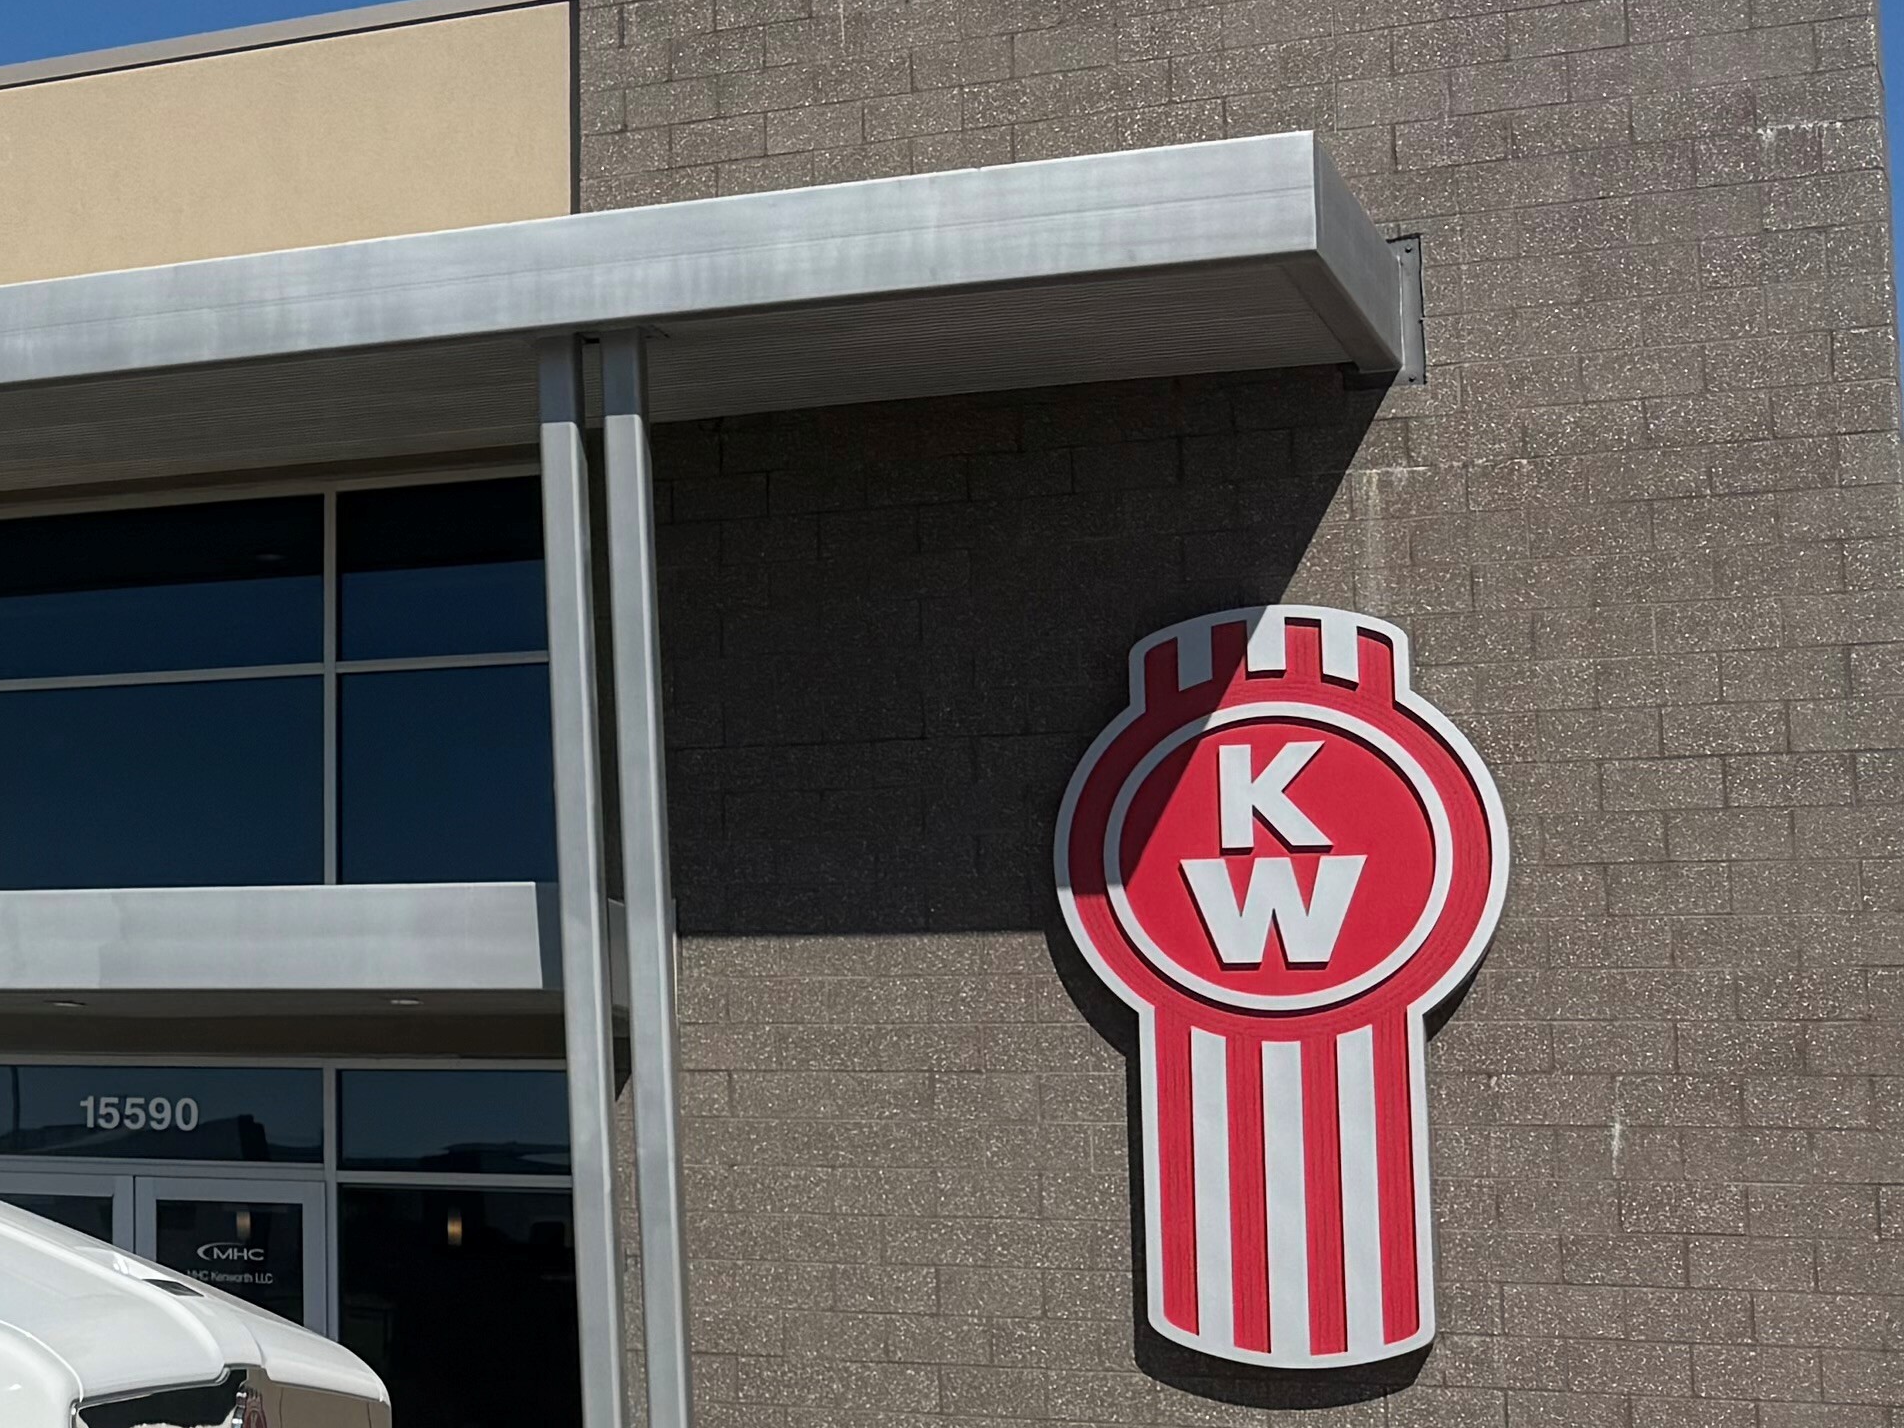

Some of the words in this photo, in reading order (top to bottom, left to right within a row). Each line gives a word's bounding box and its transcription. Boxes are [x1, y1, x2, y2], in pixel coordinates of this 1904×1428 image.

[79, 1094, 200, 1133] 15590
[213, 1246, 265, 1261] MHC
[255, 1272, 274, 1284] LLC
